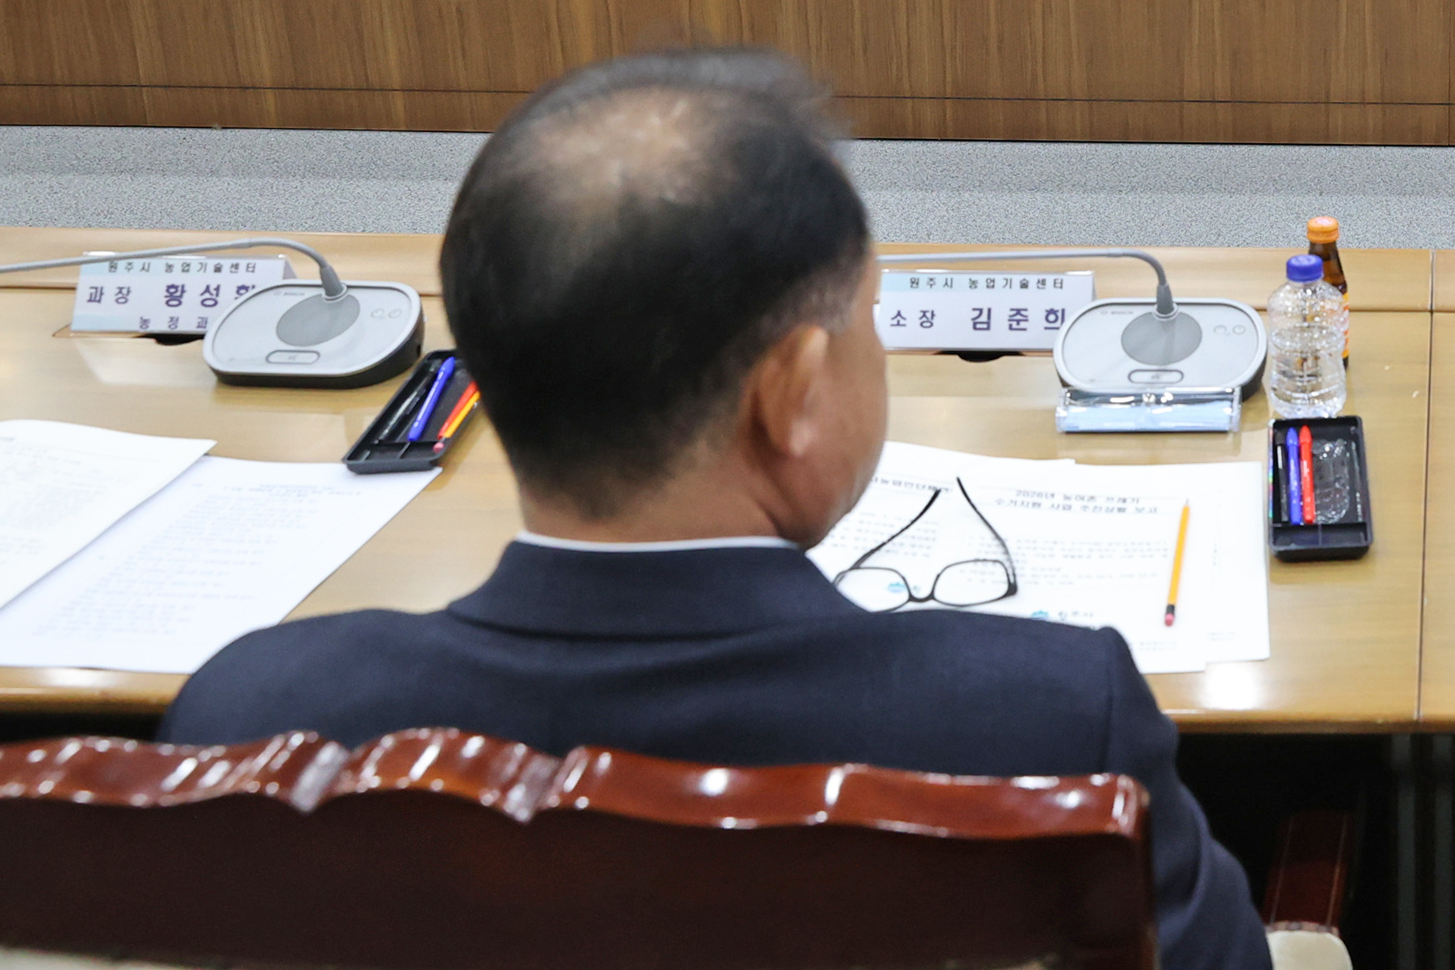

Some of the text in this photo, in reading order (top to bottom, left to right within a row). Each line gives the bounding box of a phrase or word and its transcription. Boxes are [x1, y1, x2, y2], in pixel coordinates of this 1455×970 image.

[108, 261, 256, 273] 원주시 농업기술센터
[909, 277, 1064, 290] 원주시 농업기술센터
[87, 286, 132, 304] 과장
[890, 307, 1065, 331] 소장 김준희
